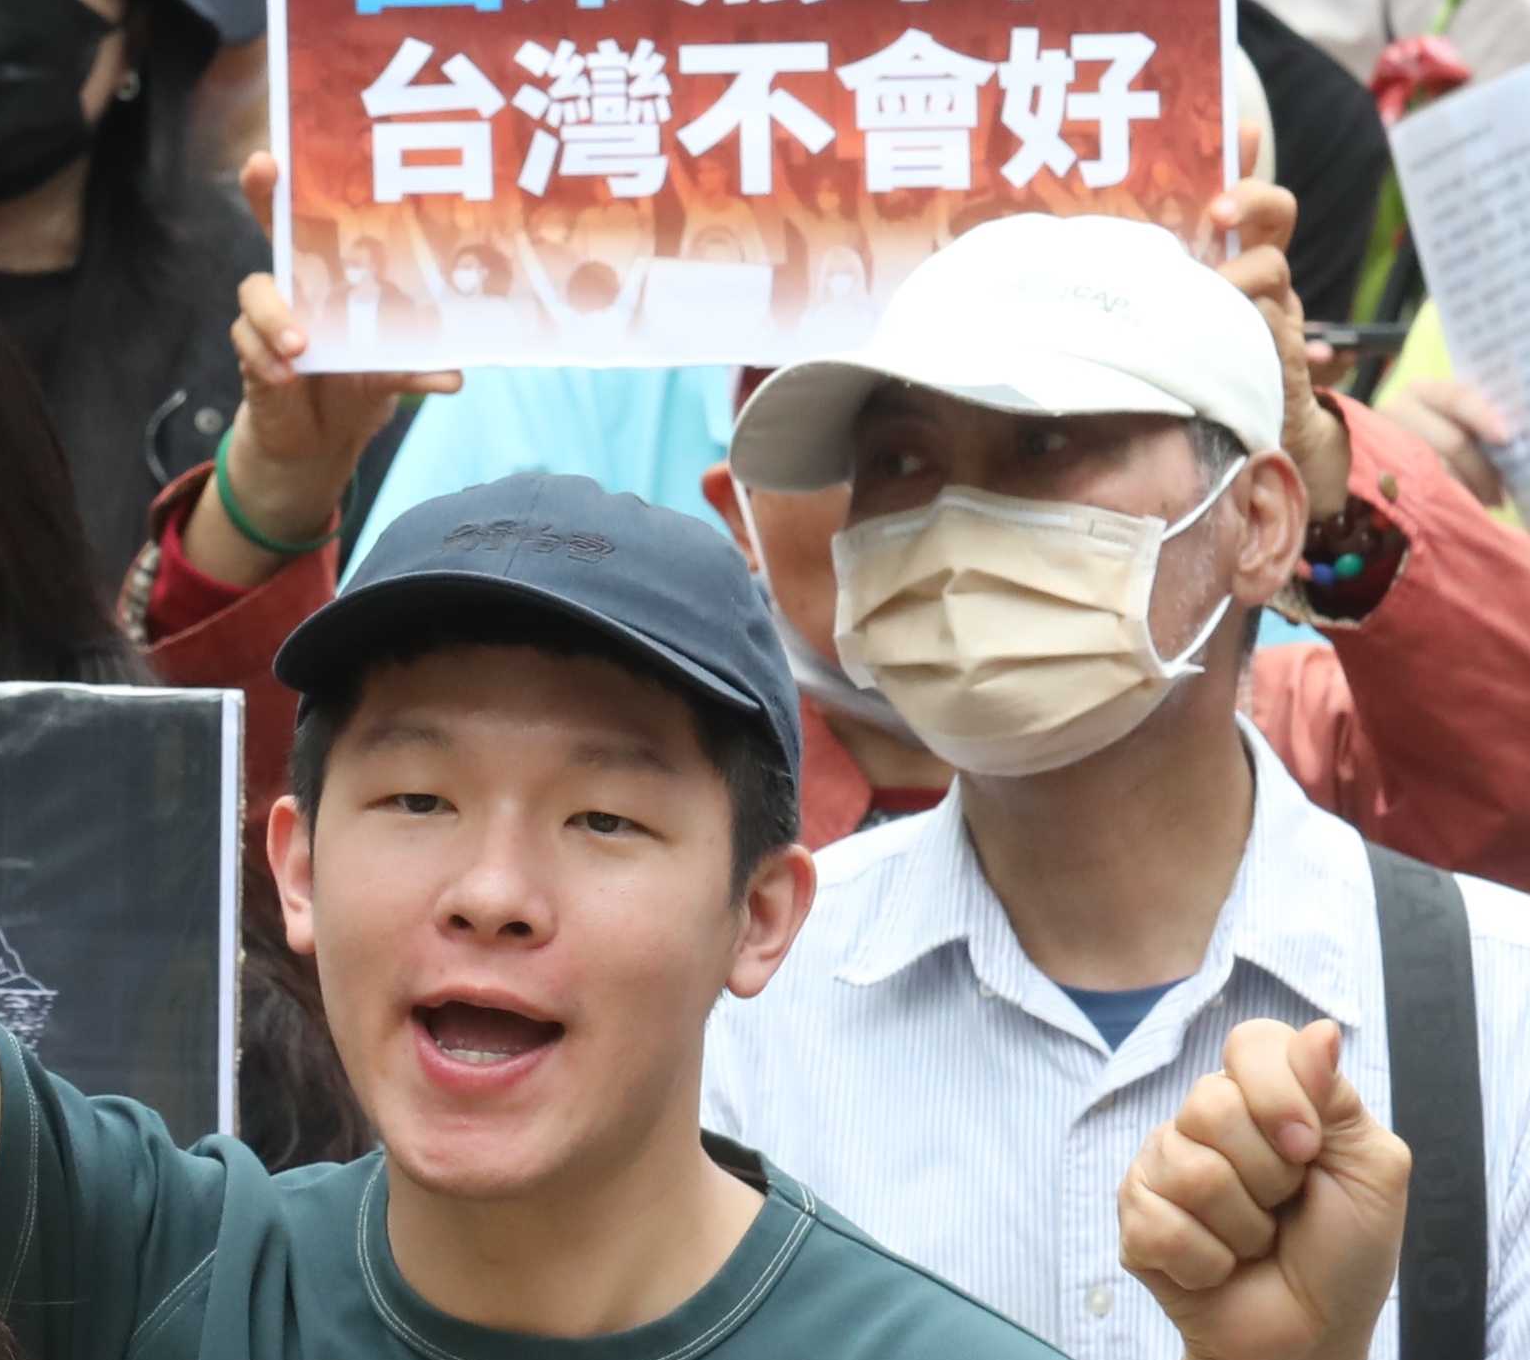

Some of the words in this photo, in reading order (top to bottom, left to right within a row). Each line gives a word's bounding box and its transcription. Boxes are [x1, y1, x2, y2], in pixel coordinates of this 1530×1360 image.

[360, 27, 1161, 205] 台灣不會好
